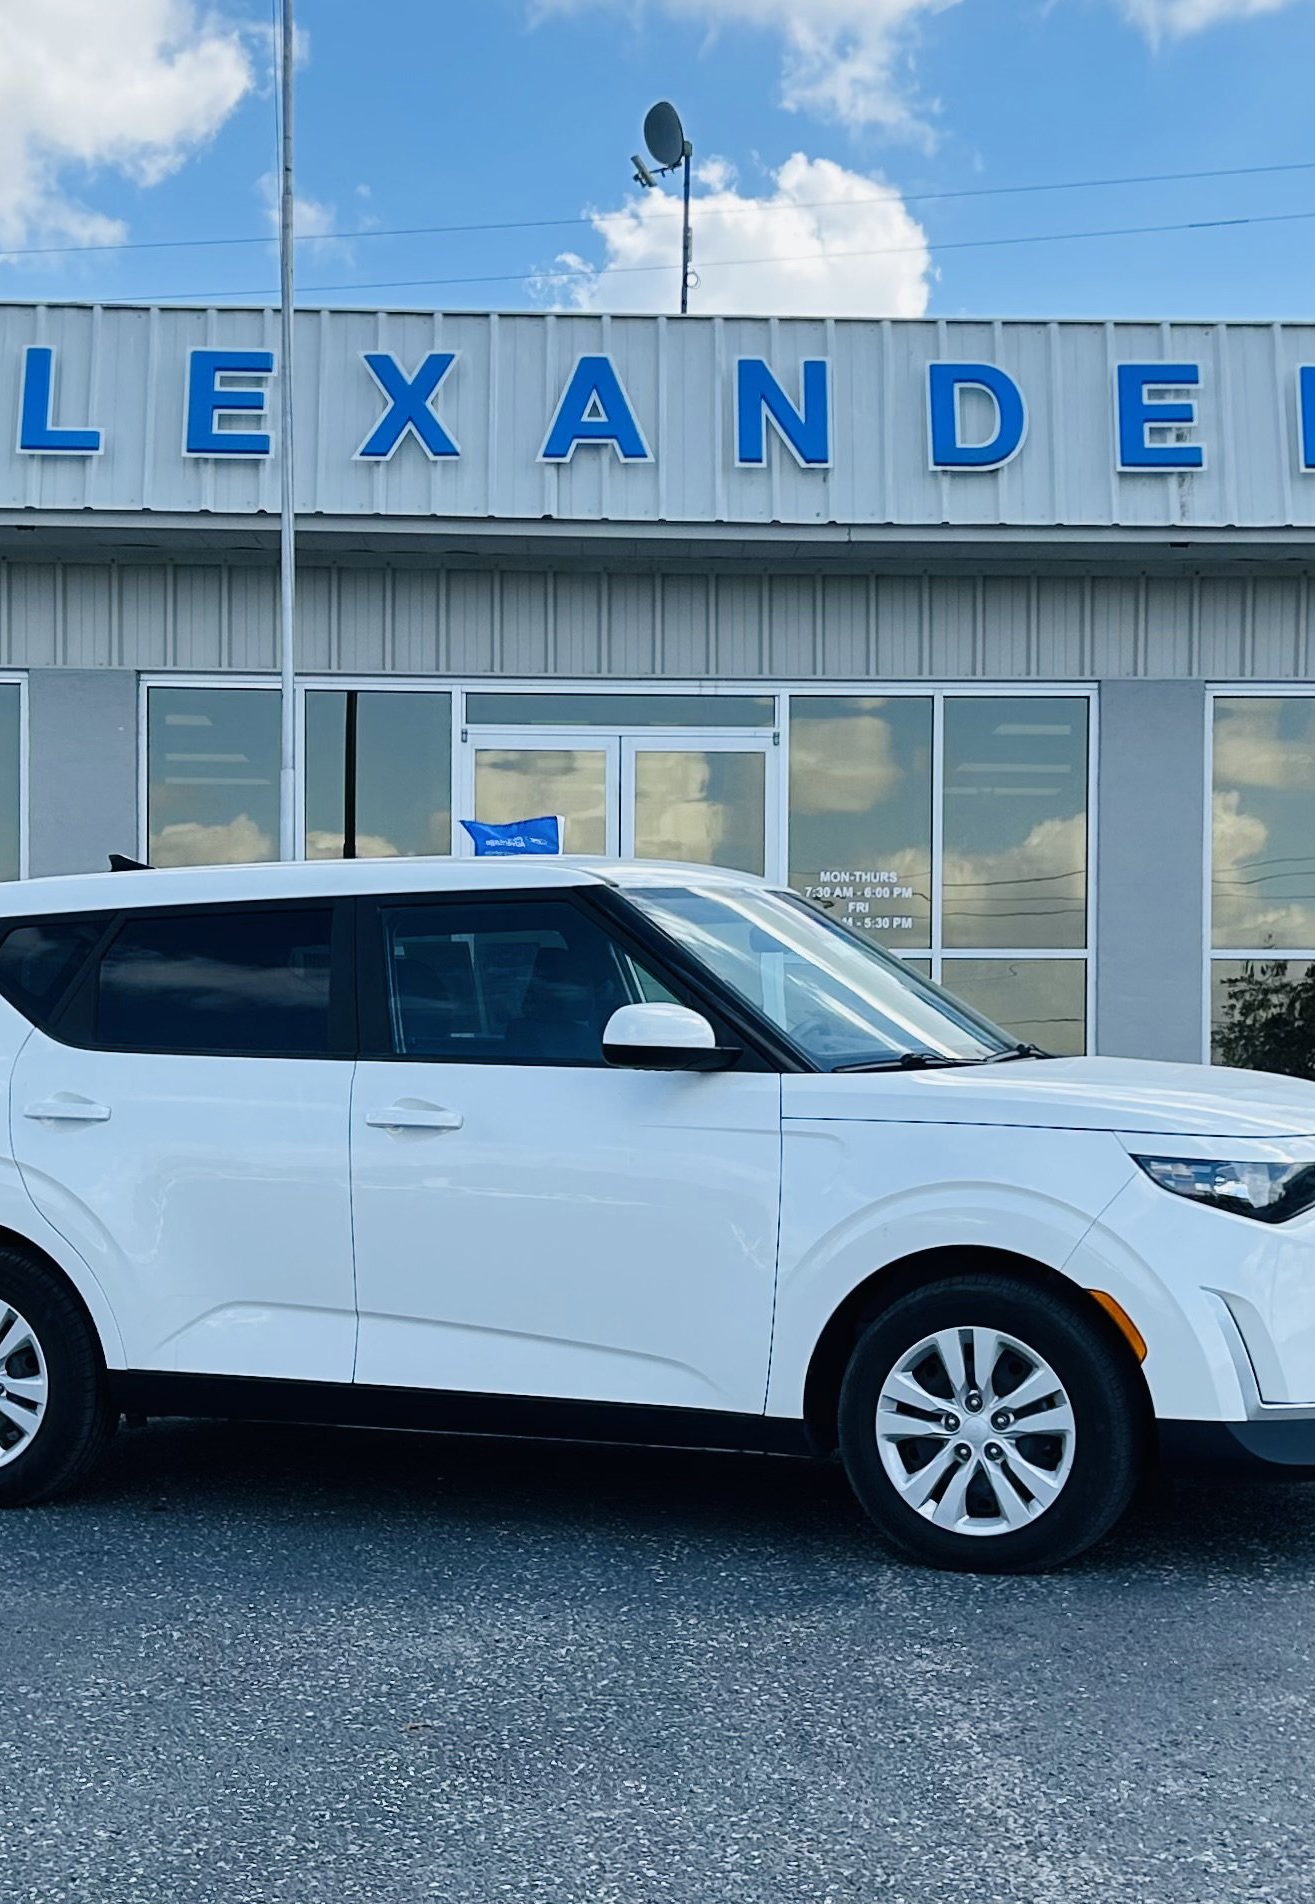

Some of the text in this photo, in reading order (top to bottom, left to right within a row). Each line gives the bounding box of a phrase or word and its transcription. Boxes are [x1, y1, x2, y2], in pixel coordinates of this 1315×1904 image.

[819, 871, 898, 882] MON-THURS
[805, 887, 831, 897] 7:30
[833, 887, 853, 898] AM
[864, 887, 890, 897] 6:00
[892, 887, 913, 897] PM
[848, 902, 869, 913] FRI
[864, 917, 890, 929] 5:30
[892, 917, 913, 928] PM
